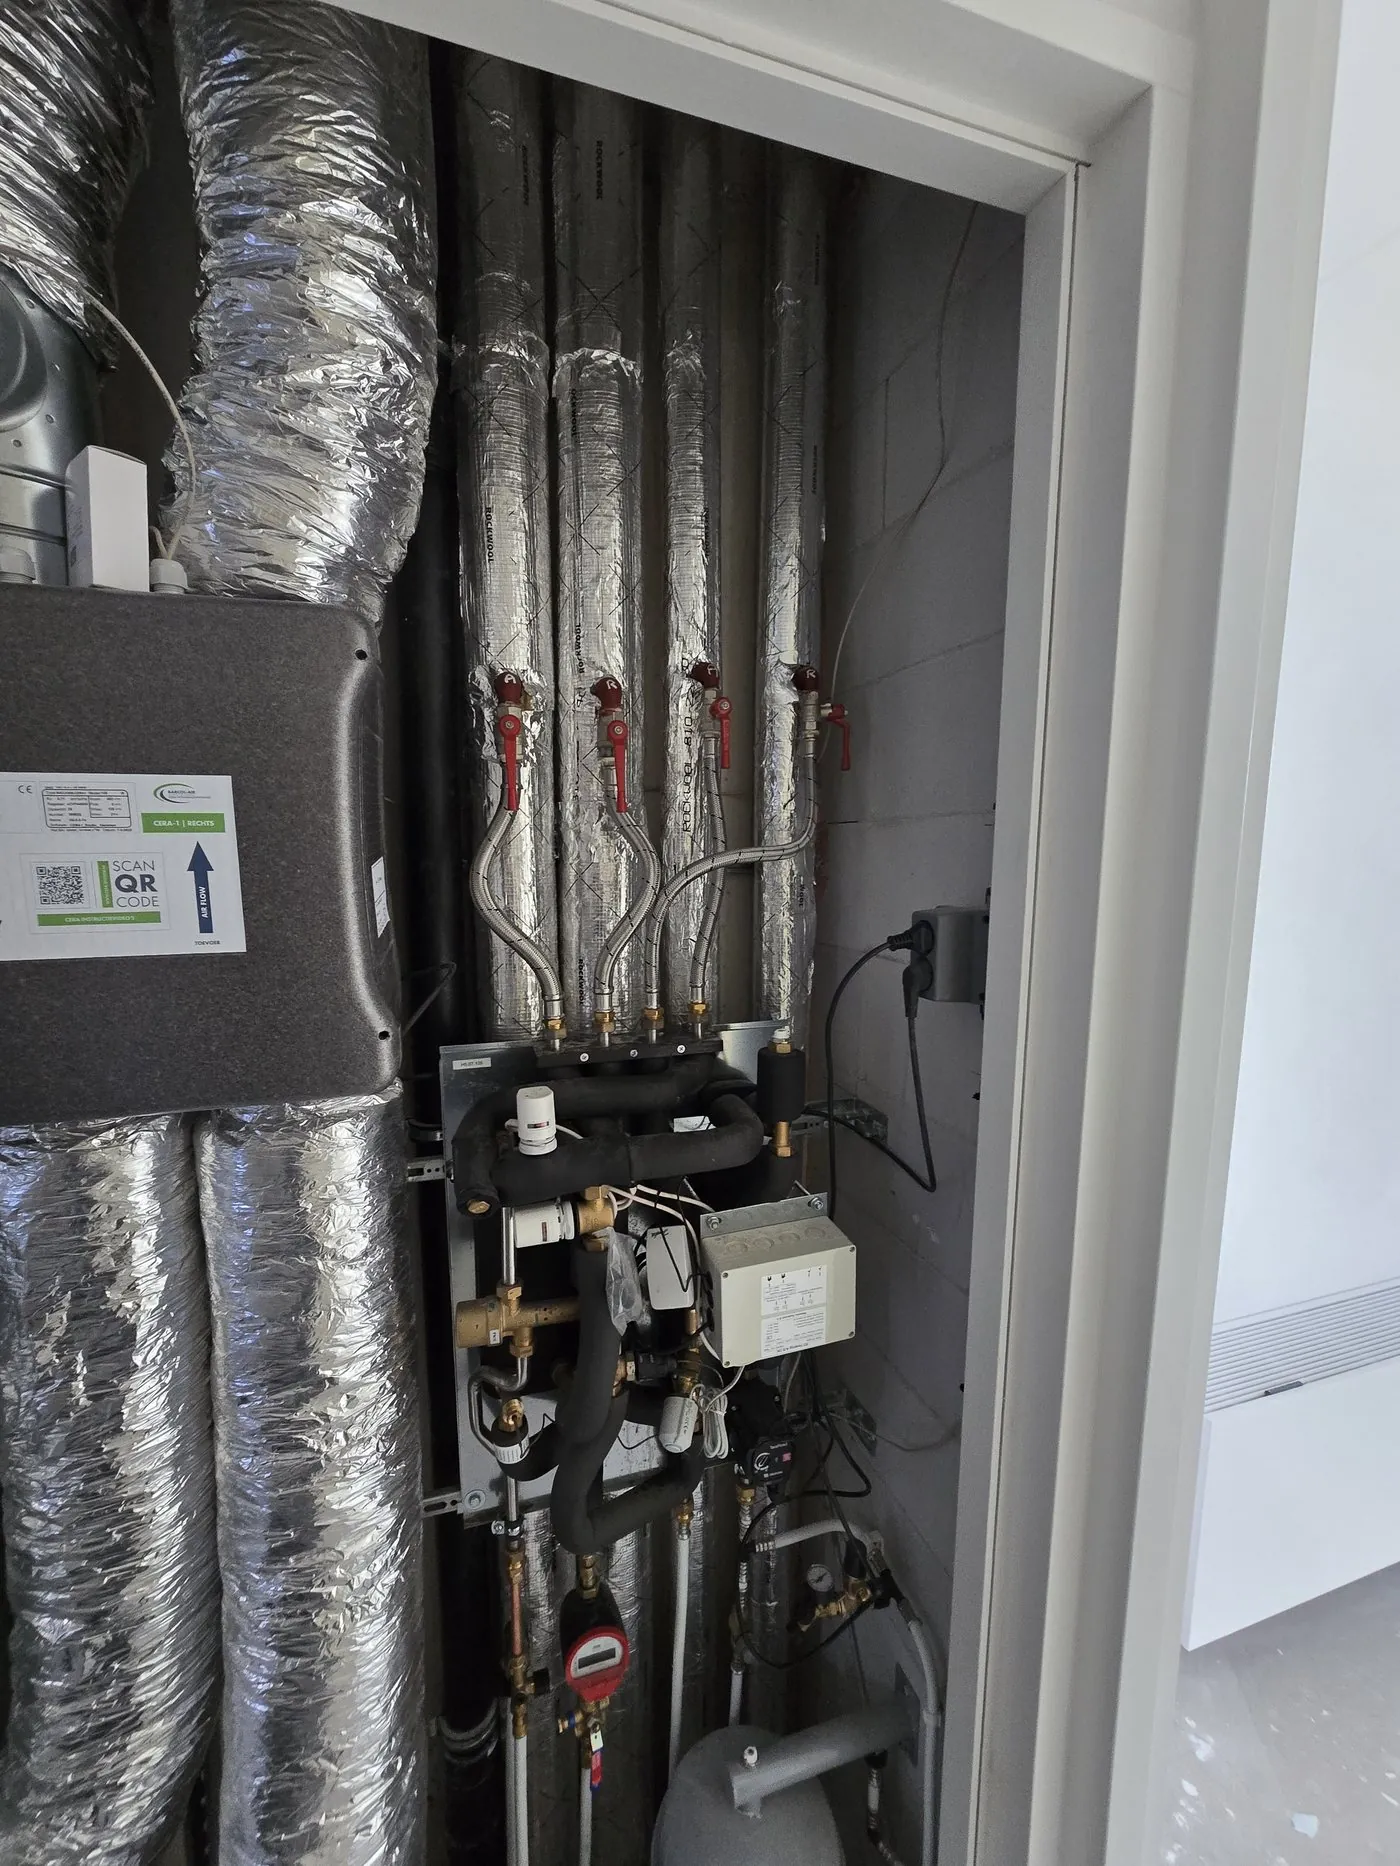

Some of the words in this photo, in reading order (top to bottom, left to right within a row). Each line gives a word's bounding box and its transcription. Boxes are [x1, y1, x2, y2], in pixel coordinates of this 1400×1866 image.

[485, 507, 494, 564] ROCKWOOL
[504, 673, 516, 684] A
[806, 668, 817, 679] R
[606, 679, 618, 690] R
[187, 820, 215, 828] RECHTS
[112, 860, 155, 872] SCAN
[114, 873, 158, 893] QR
[116, 896, 160, 908] CODE
[198, 886, 208, 906] FLOW
[200, 906, 209, 919] AIR
